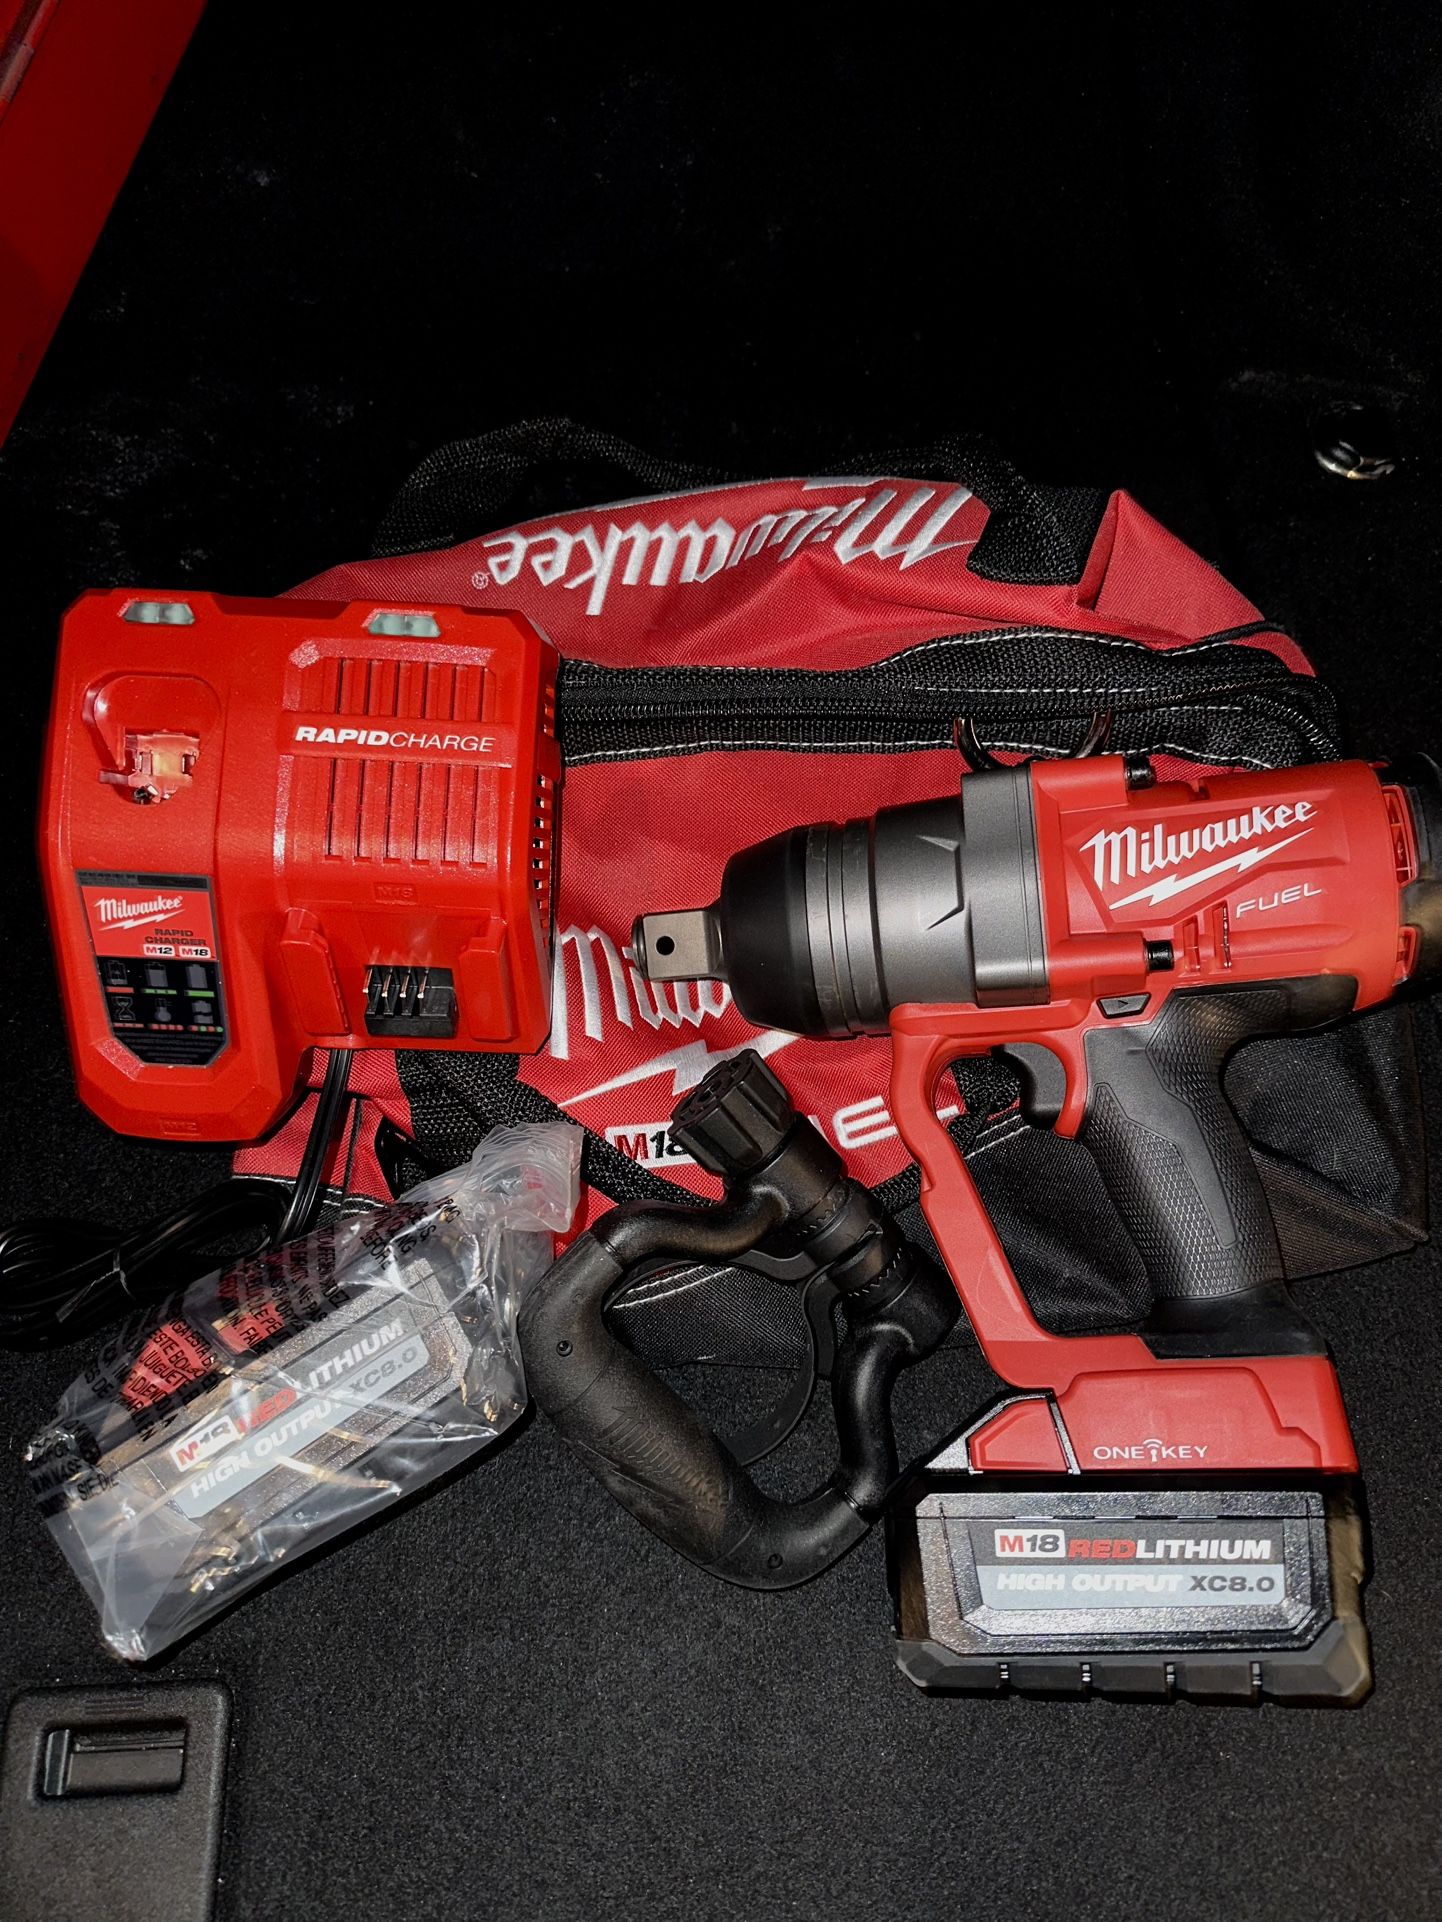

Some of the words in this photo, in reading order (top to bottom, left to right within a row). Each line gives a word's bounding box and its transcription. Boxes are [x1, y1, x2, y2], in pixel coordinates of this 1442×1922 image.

[483, 486, 978, 616] Milwaukee
[295, 726, 497, 752] RAPIDCHARGE
[1080, 800, 1318, 892] Milwaukee
[94, 895, 183, 923] Milwaukee
[1236, 882, 1322, 919] FUEL
[145, 936, 207, 946] CHARGER
[155, 928, 194, 938] RAPID
[144, 945, 174, 956] M12
[181, 947, 210, 958] M18
[190, 1452, 252, 1499] HIGH
[350, 1348, 417, 1394] XC8.0
[999, 1533, 1061, 1554] M18
[996, 1572, 1066, 1592] HIGH
[1071, 1573, 1184, 1593] OUTPUT
[1187, 1575, 1275, 1593] XC8.0
